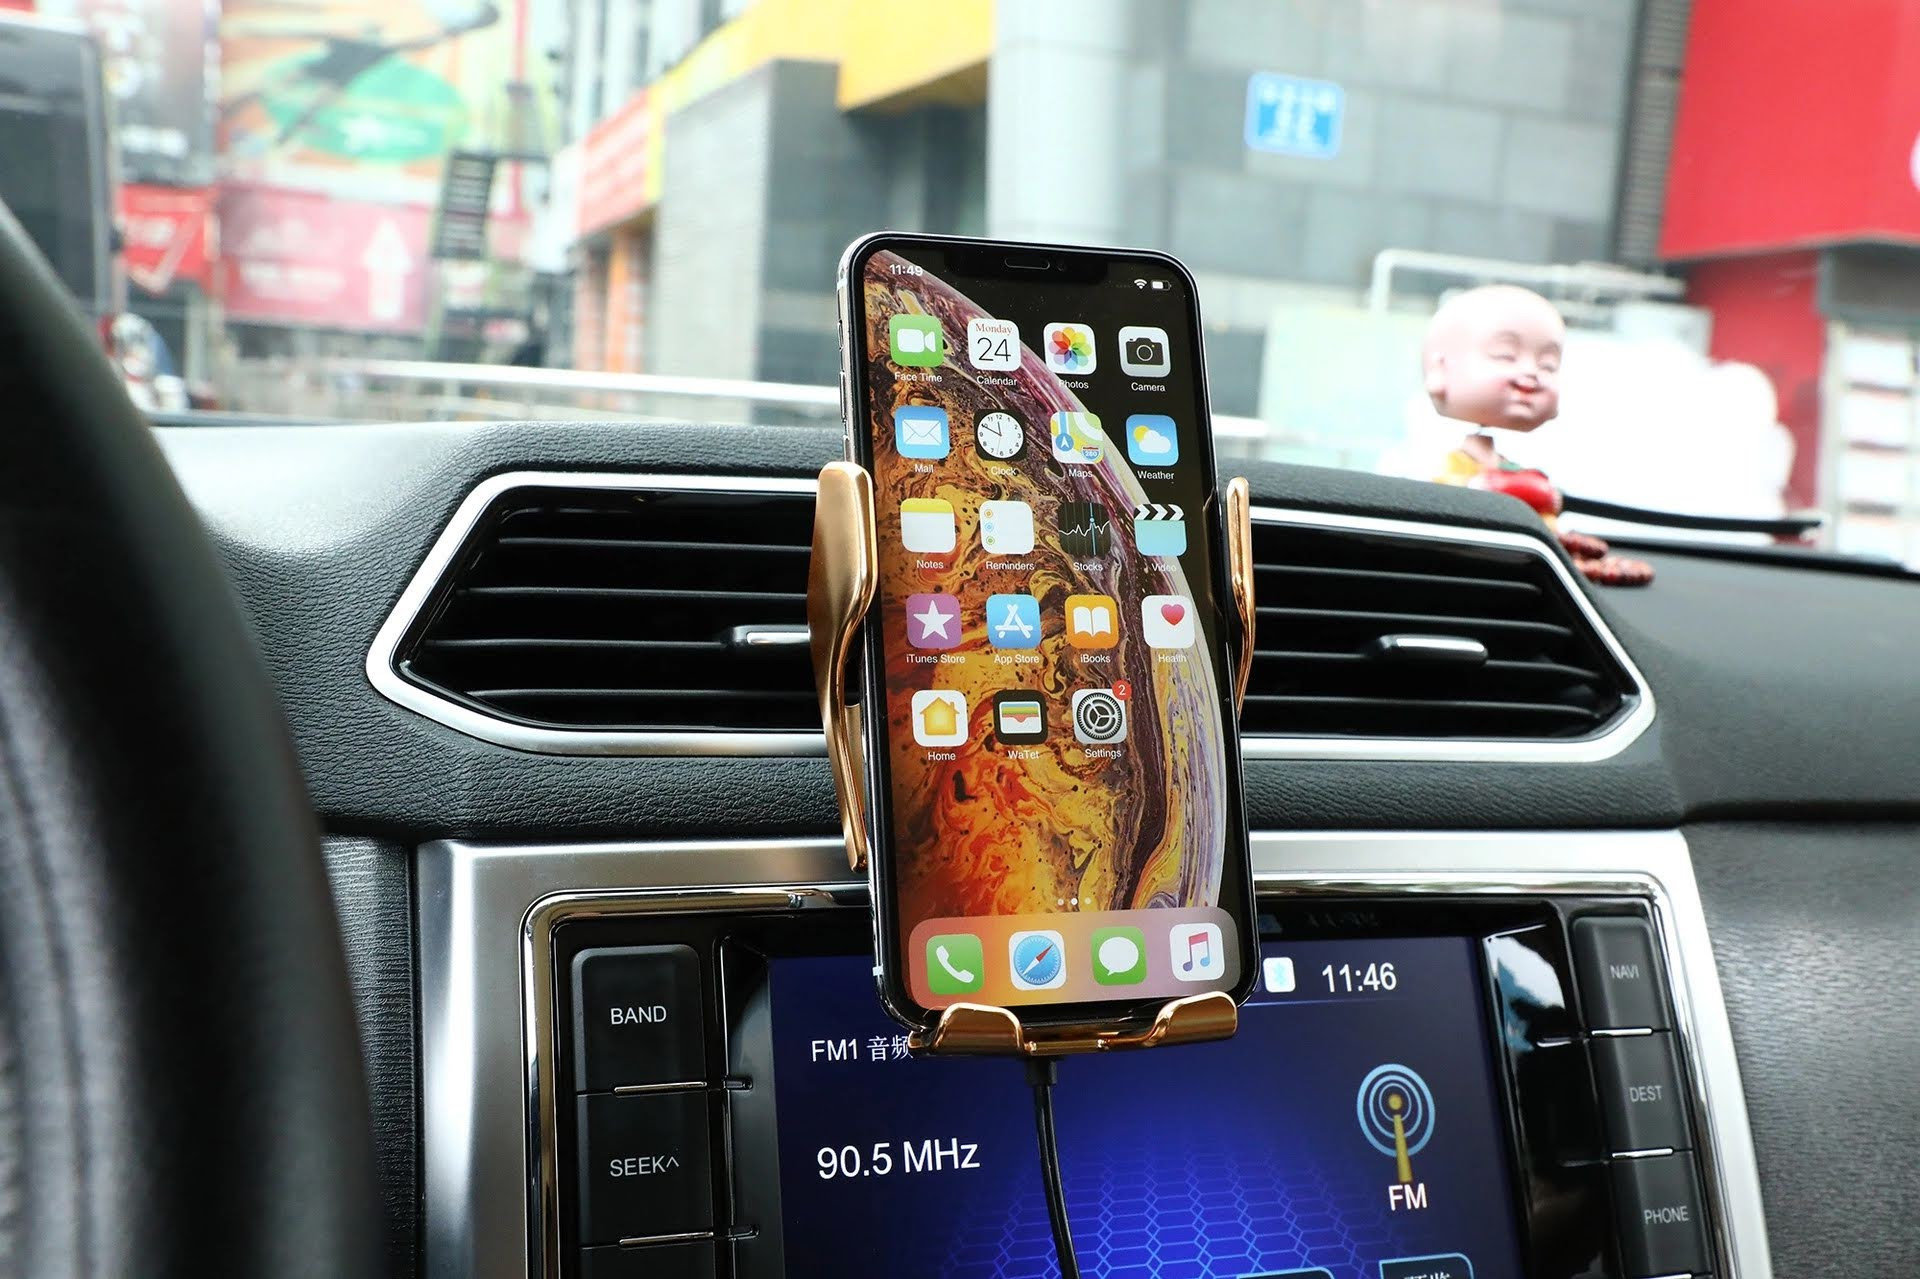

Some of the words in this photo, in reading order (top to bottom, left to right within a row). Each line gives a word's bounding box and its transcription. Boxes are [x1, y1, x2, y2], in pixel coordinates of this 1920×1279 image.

[889, 264, 923, 276] 11:49
[975, 323, 1013, 336] Monday
[977, 337, 1011, 362] 24
[894, 372, 917, 381] Face
[920, 373, 943, 383] Time
[976, 375, 1018, 386] Calendar
[1058, 378, 1089, 389] Photos
[1131, 381, 1166, 392] Camera
[914, 463, 934, 473] Mail
[990, 465, 1017, 476] Clock
[1068, 468, 1093, 479] Maps
[1137, 470, 1175, 480] Weather
[916, 560, 944, 570] Notes
[985, 560, 1035, 571] Reminders
[1073, 562, 1103, 572] Stocks
[1152, 563, 1177, 572] Video
[906, 653, 938, 664] iTunes
[940, 653, 966, 664] Store
[994, 654, 1014, 665] App
[1015, 653, 1040, 664] Store
[1080, 653, 1111, 663] iBooks
[1158, 654, 1187, 663] Health
[1118, 684, 1126, 696] 2
[927, 751, 956, 761] Home
[1084, 748, 1122, 760] Settings
[1322, 962, 1397, 993] 11:46
[1610, 965, 1639, 980] NAVI
[610, 1005, 667, 1025] BAND
[811, 1038, 858, 1062] FM1
[1629, 1085, 1663, 1103] DEST
[817, 1142, 892, 1180] 90.5
[903, 1138, 981, 1174] MHz
[1388, 1183, 1428, 1211] FM
[1643, 1206, 1689, 1224] PHONE
